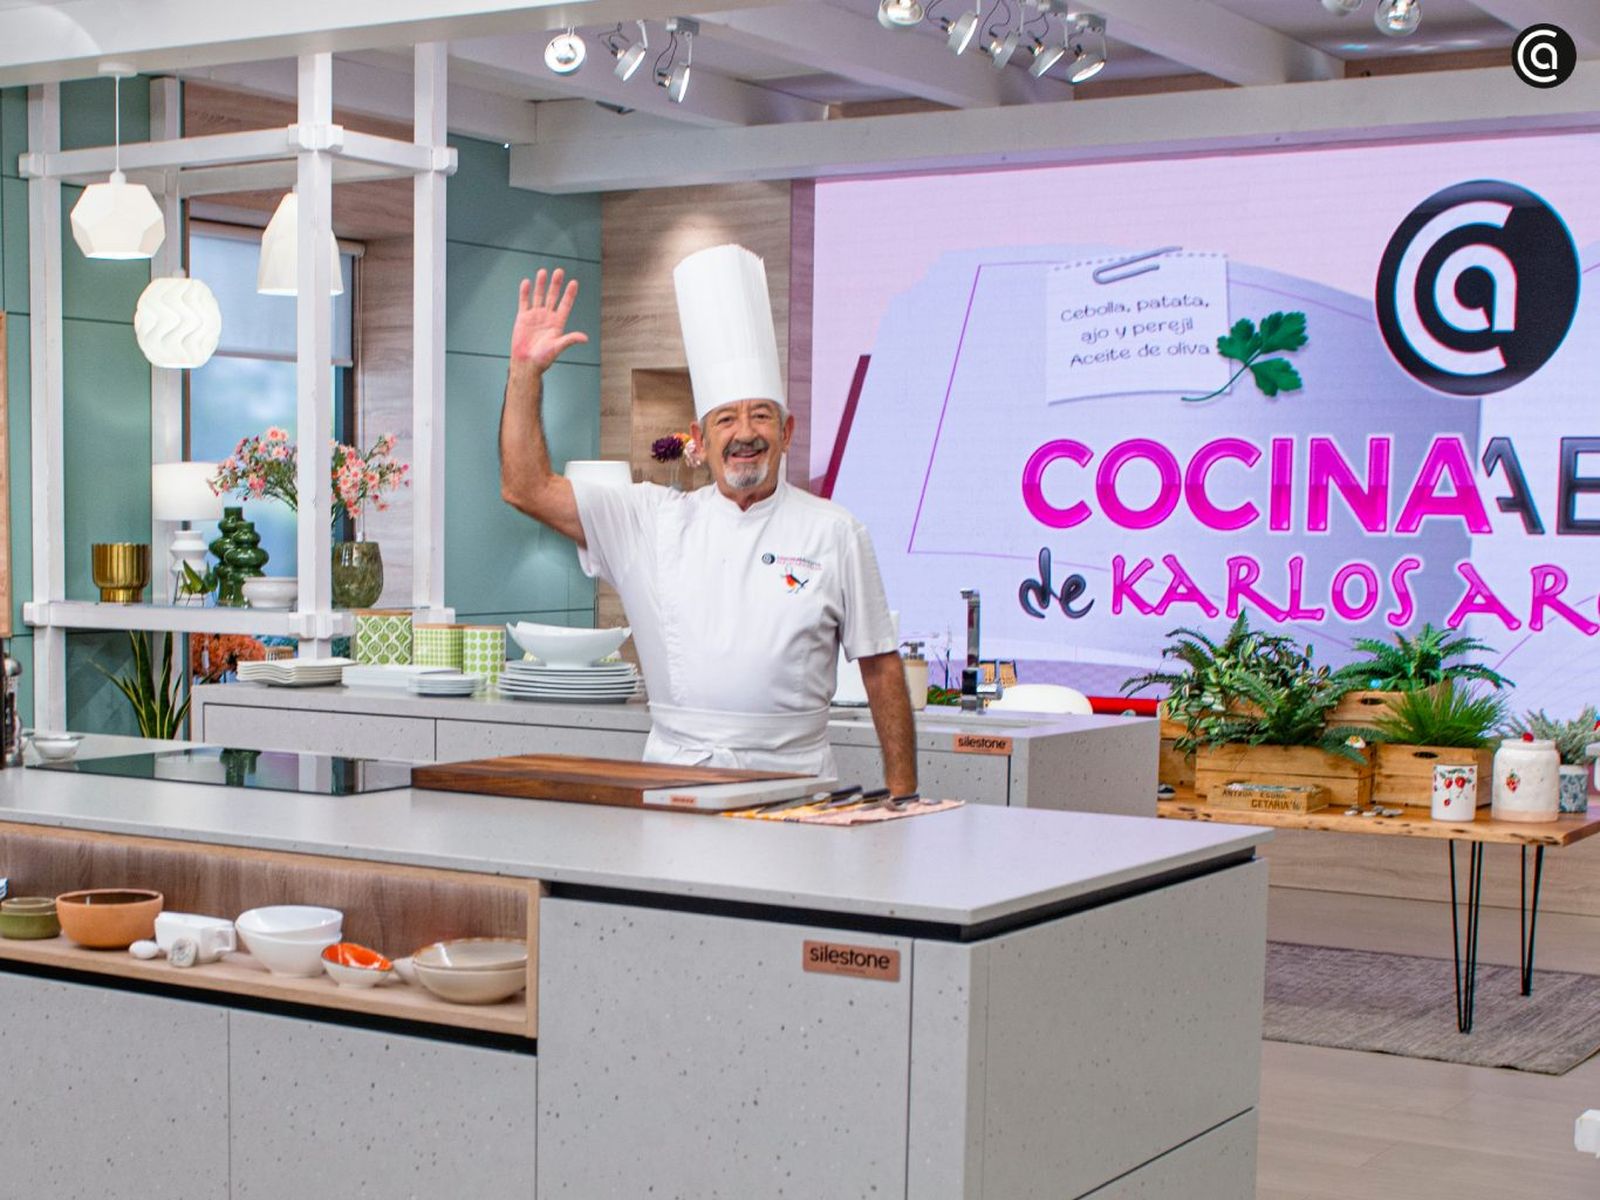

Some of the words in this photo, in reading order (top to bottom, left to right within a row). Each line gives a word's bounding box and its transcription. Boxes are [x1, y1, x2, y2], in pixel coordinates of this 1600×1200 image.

[1136, 294, 1210, 313] patata,
[1081, 328, 1110, 344] ajo
[1115, 326, 1128, 339] y
[1132, 317, 1194, 337] perejil
[1069, 348, 1131, 368] Aceite
[1137, 343, 1161, 358] de
[1167, 342, 1210, 356] oliva
[1018, 546, 1095, 620] de
[1111, 554, 1421, 627] KARLOS
[1446, 562, 1600, 636] AR
[957, 735, 1006, 750] silestone
[809, 944, 891, 970] silestone
